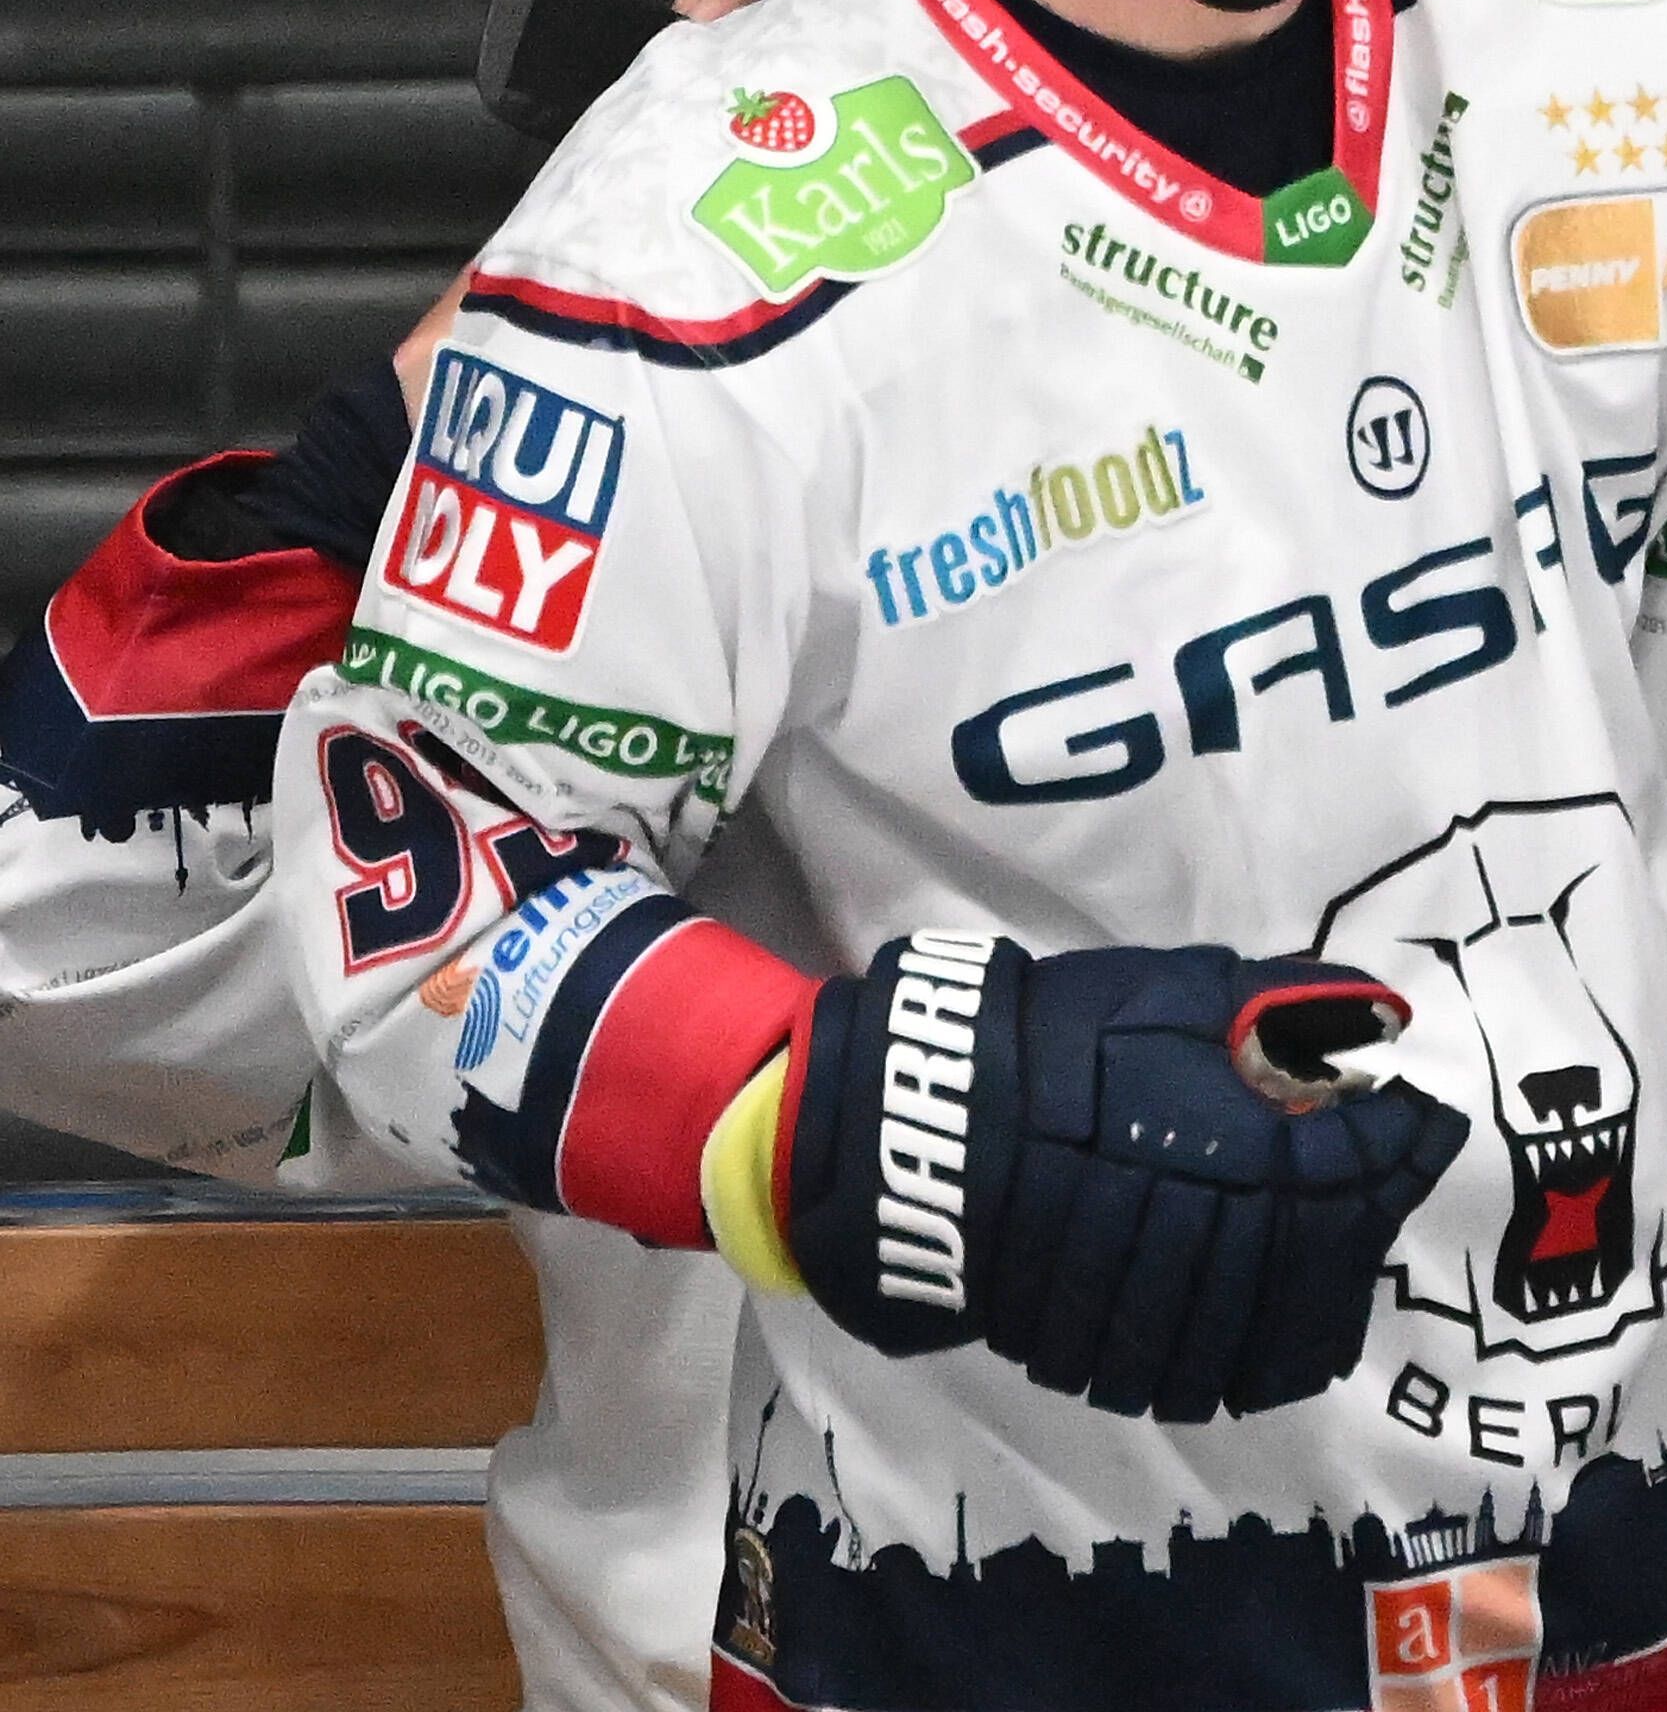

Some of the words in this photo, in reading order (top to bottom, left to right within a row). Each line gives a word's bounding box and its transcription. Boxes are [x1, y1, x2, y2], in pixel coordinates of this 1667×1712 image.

[722, 118, 949, 274] Karls
[1275, 193, 1352, 248] LIGO
[1061, 222, 1280, 352] structure
[866, 424, 1206, 627] freshfoodz
[379, 650, 509, 730] LIGO
[527, 705, 658, 767] LIGO
